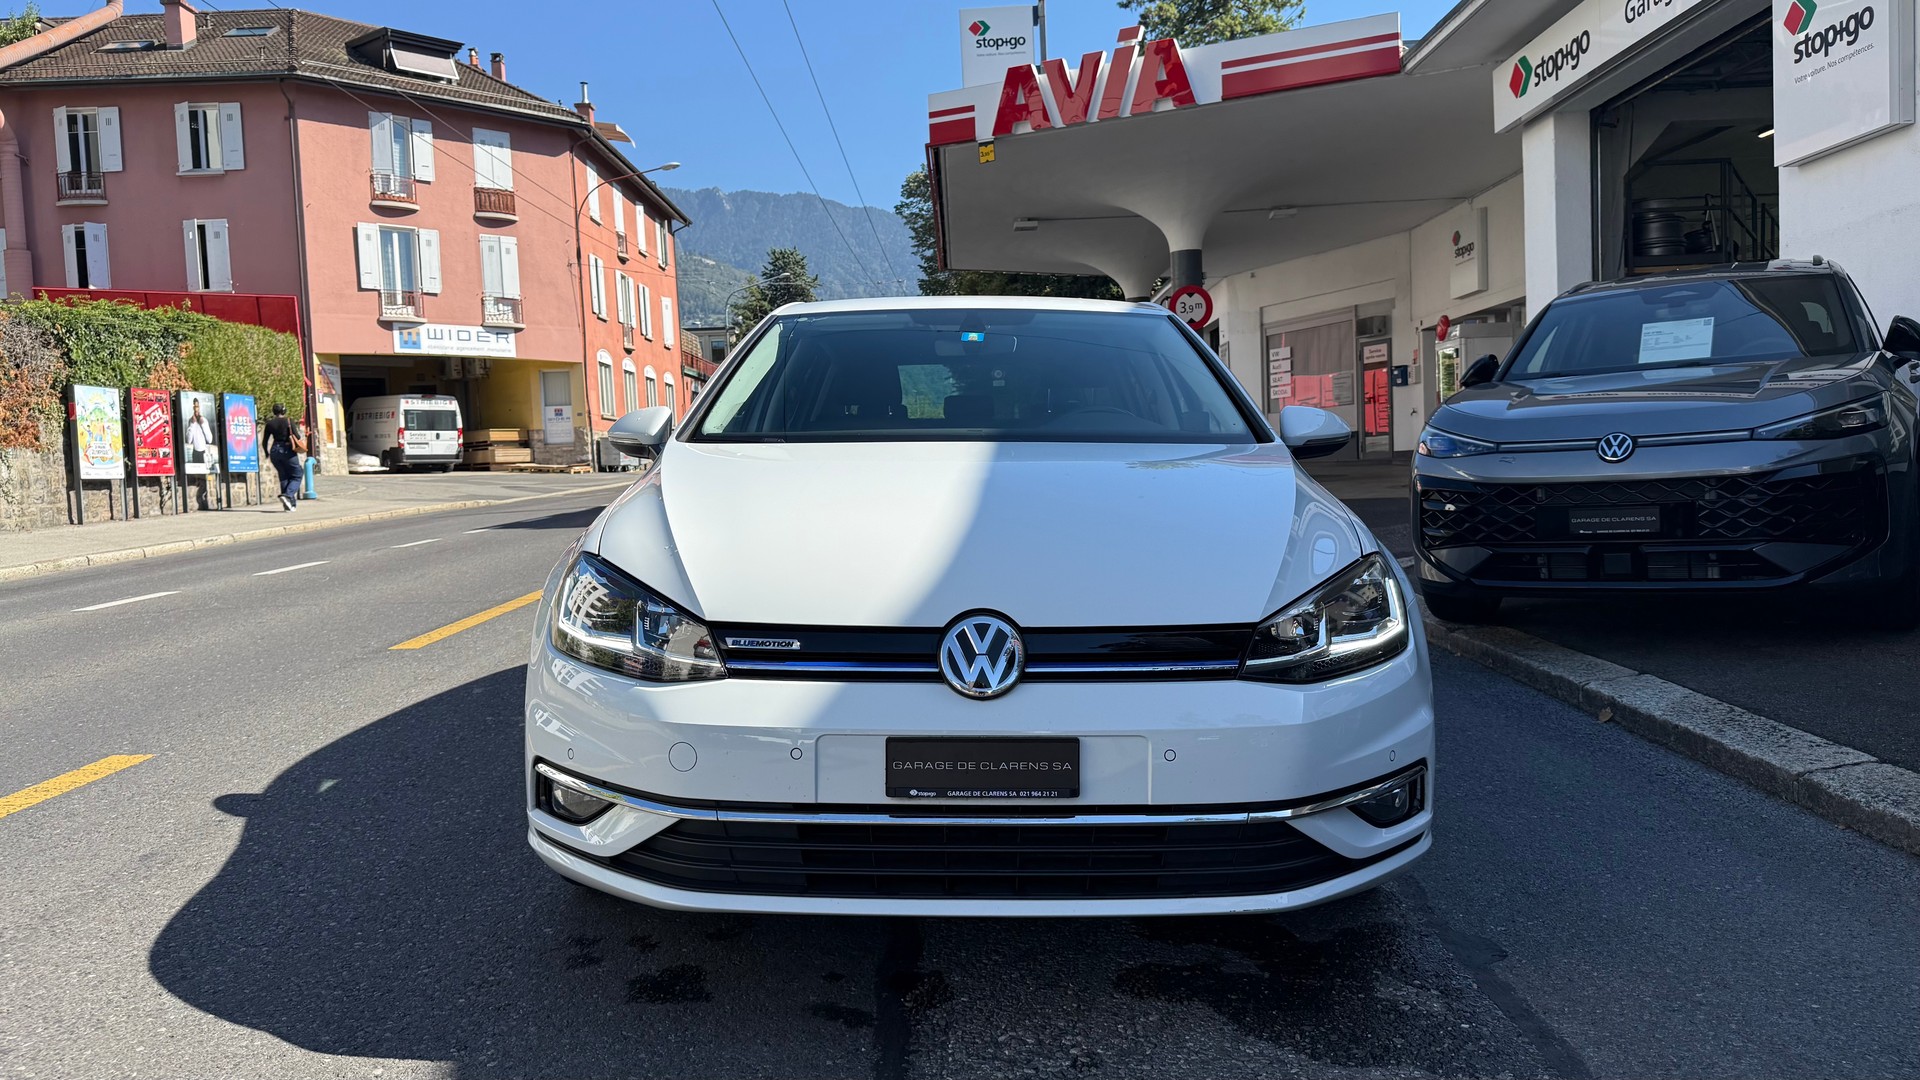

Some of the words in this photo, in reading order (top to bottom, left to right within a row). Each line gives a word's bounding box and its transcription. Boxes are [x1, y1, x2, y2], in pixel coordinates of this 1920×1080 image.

[1793, 6, 1875, 64] stop+go
[976, 36, 1026, 50] stop+go
[1533, 30, 1591, 87] stop+go
[427, 328, 510, 344] WIDER
[140, 407, 163, 431] BACH
[229, 415, 252, 425] LABEL
[360, 411, 391, 420] STRIEBIG
[230, 425, 252, 435] SUISSE
[731, 639, 795, 648] BLUEMOTION
[892, 761, 954, 770] GARAGE
[957, 761, 977, 770] DE
[980, 761, 1049, 770] CLARENS
[1052, 761, 1072, 770] SA
